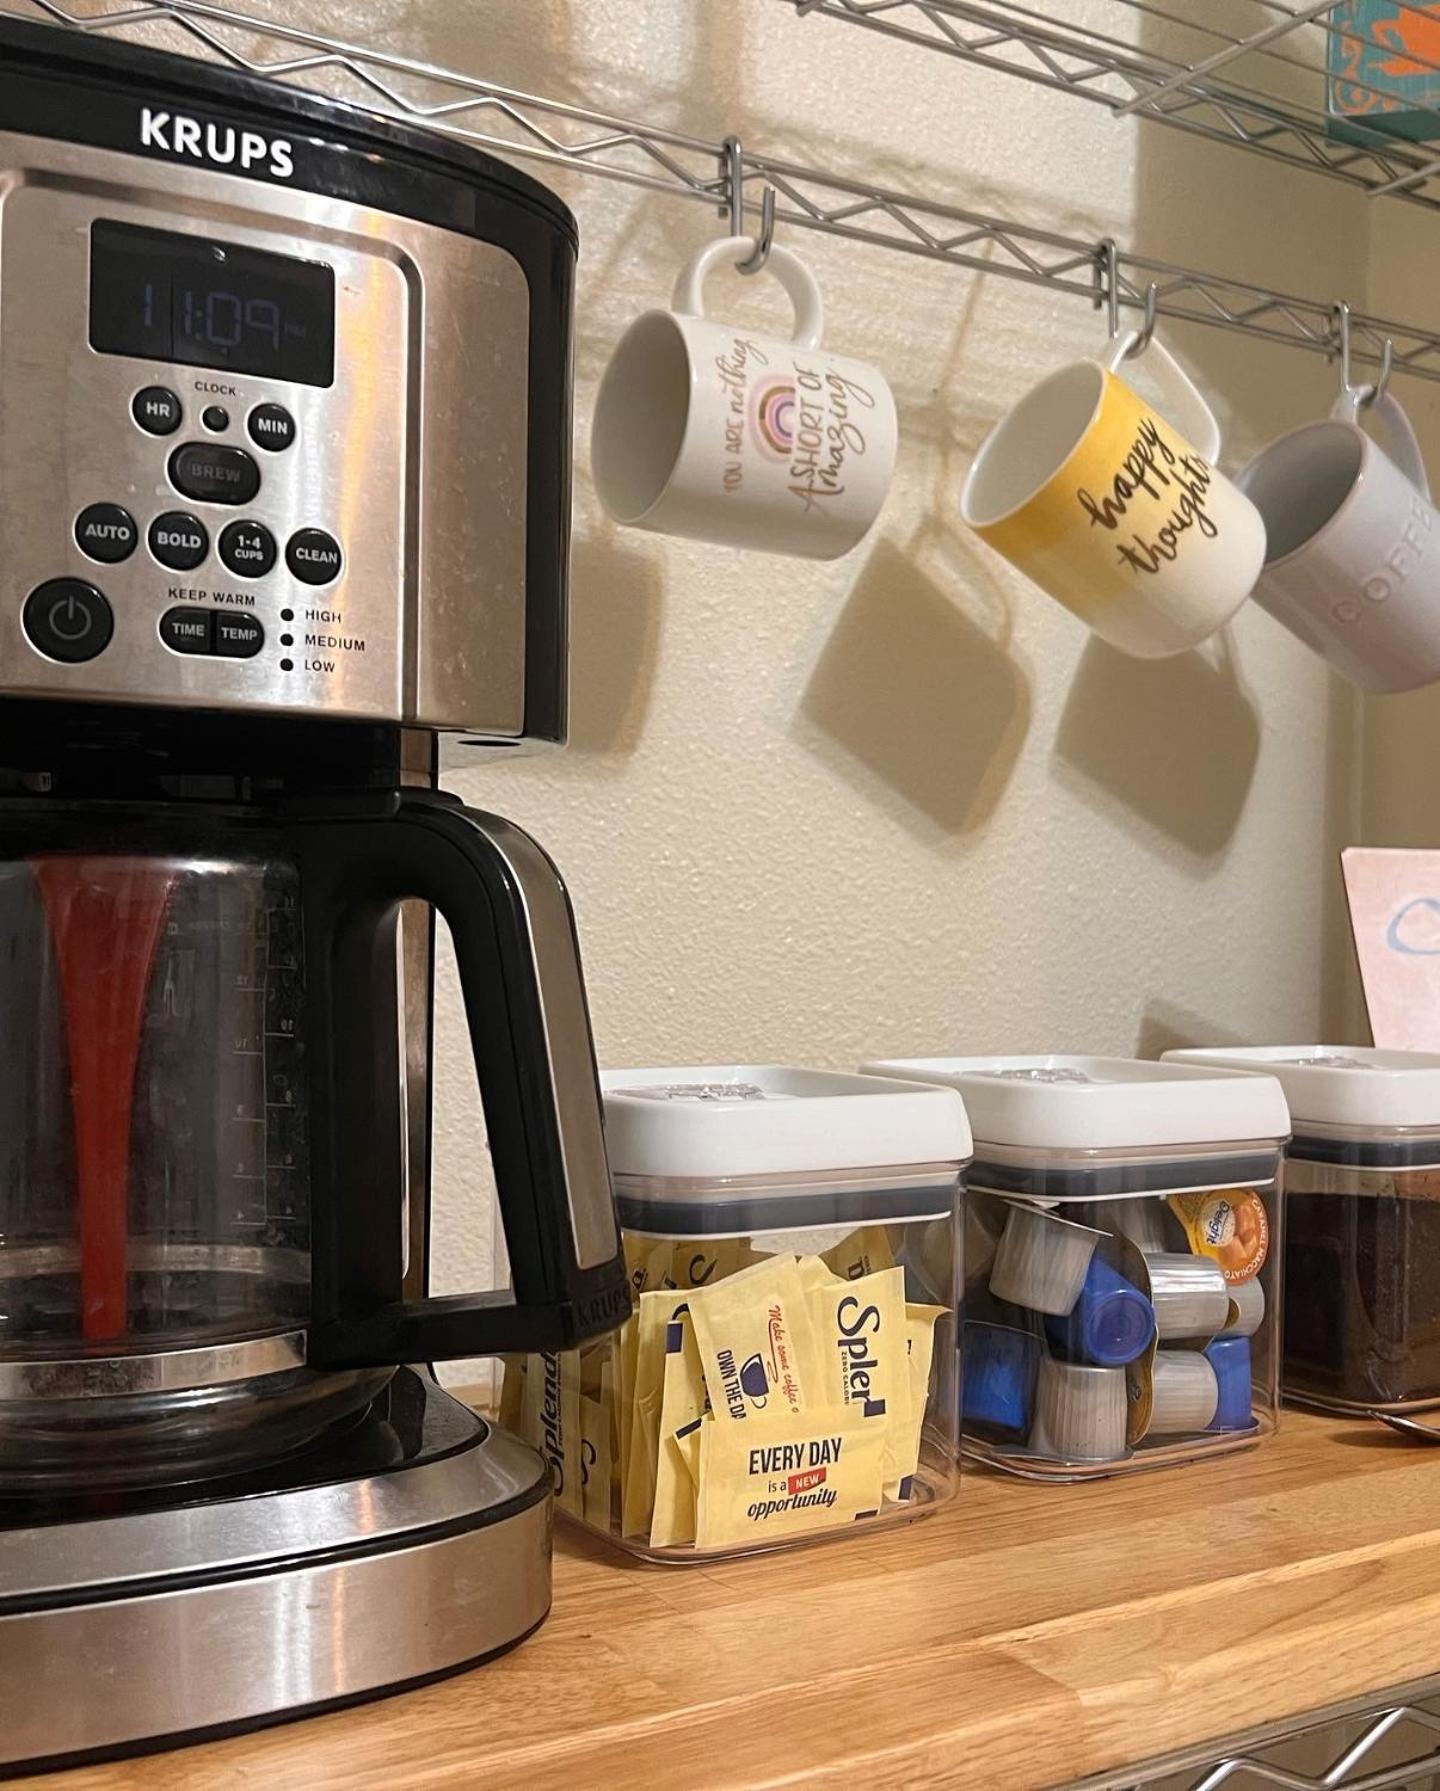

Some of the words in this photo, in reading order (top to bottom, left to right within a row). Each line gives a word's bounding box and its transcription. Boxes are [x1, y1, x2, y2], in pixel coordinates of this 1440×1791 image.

[141, 108, 294, 178] KRUPS
[194, 381, 237, 396] CLOCK
[146, 402, 171, 417] HR
[258, 417, 288, 435] MIN
[791, 397, 825, 478] SHORT
[191, 463, 241, 482] BREW
[1077, 418, 1176, 530] happy
[1116, 454, 1218, 574] thoughts
[85, 523, 131, 541] AUTO
[157, 531, 201, 549] BOLD
[238, 535, 262, 549] 1-4
[235, 548, 264, 562] CUPS
[296, 548, 338, 564] CLEAN
[168, 588, 207, 601] KEEP
[213, 591, 256, 606] WARM
[305, 609, 342, 623] HIGH
[172, 622, 206, 637] TIME
[221, 627, 258, 641] TEMP
[305, 634, 366, 651] MEDIUM
[304, 660, 336, 673] LOW
[1206, 1200, 1231, 1245] Delight
[768, 1304, 785, 1342] Make
[717, 1349, 737, 1380] OWN
[778, 1345, 790, 1371] some
[725, 1378, 743, 1405] THE
[782, 1374, 799, 1404] coffee
[749, 1443, 805, 1475] EVERY
[809, 1437, 842, 1467] DAY
[768, 1480, 777, 1493] is
[780, 1480, 787, 1491] a
[795, 1473, 820, 1489] NEW
[747, 1488, 837, 1521] opportunity
